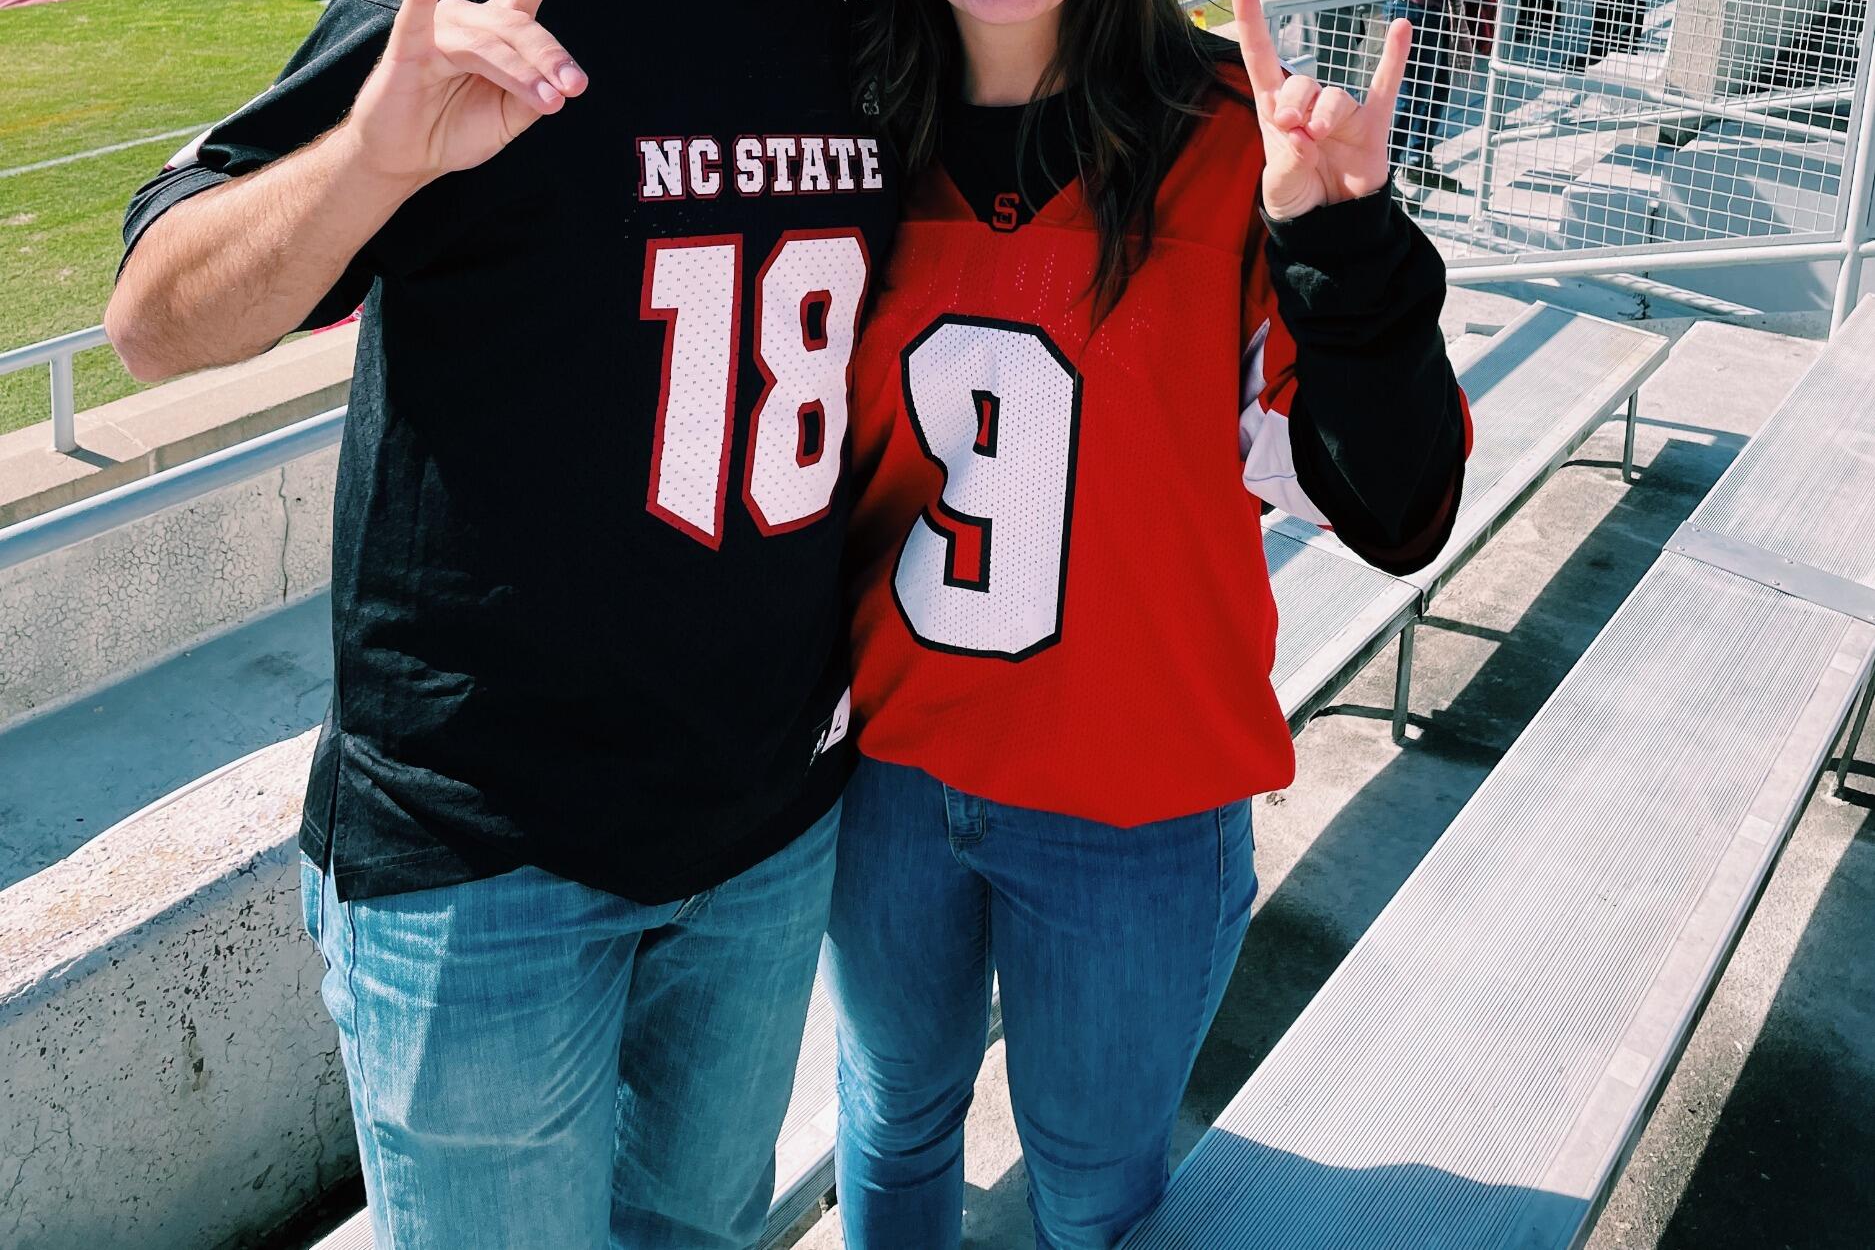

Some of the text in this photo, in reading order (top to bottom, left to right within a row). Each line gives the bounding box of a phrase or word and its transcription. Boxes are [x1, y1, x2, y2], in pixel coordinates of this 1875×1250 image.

[636, 135, 883, 201] NC STATE
[992, 192, 1020, 230] S
[640, 227, 870, 551] 18
[890, 313, 1084, 663] 9
